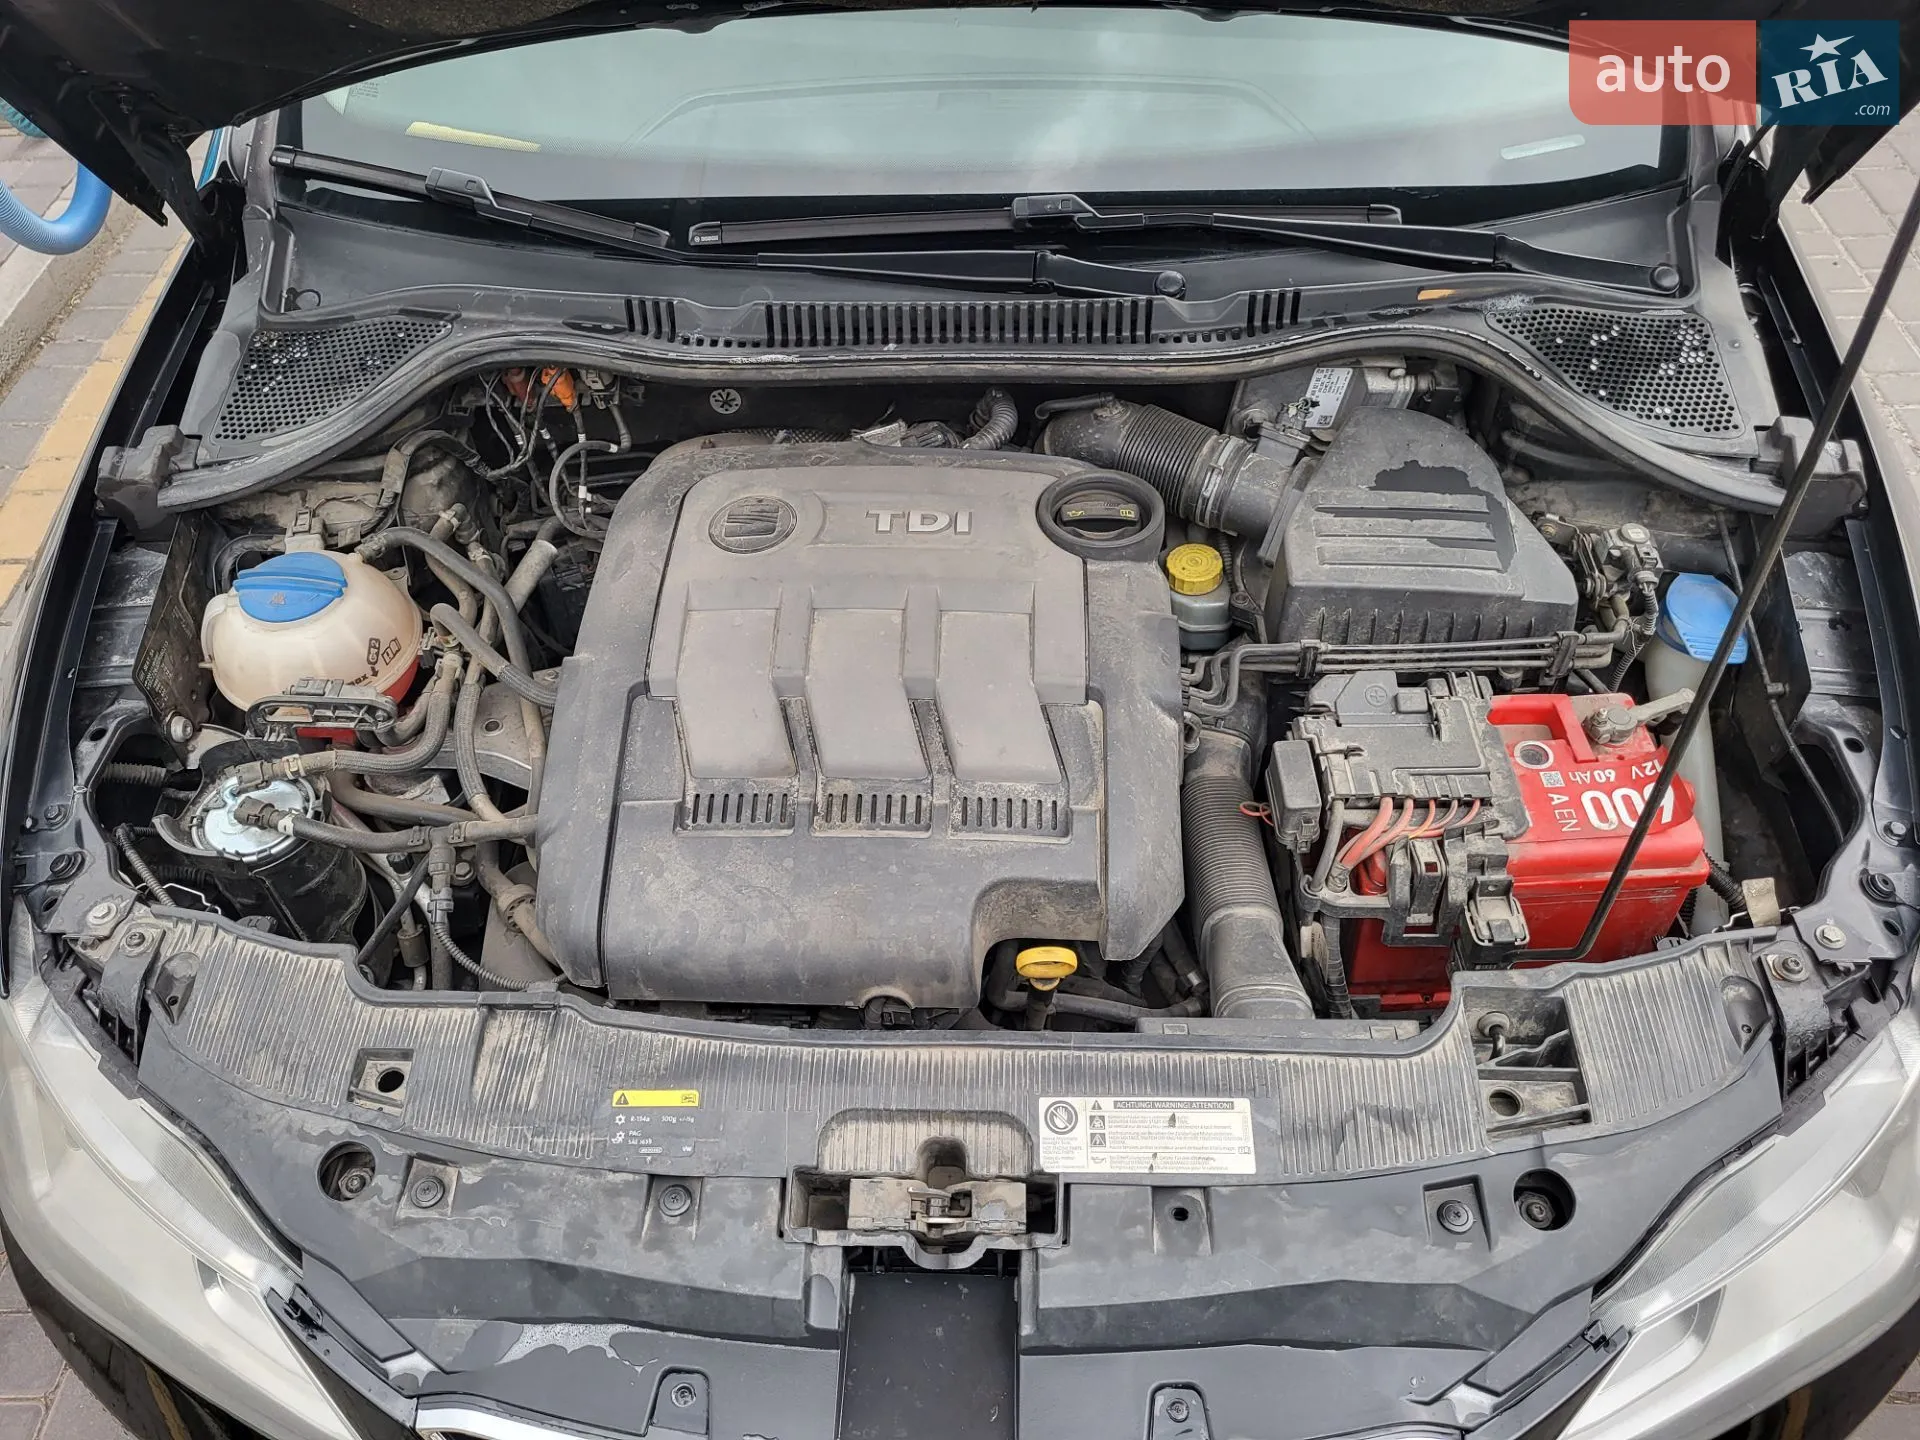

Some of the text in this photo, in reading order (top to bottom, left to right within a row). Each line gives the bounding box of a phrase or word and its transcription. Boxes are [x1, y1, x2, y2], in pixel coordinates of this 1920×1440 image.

[865, 510, 973, 535] TDI
[1580, 782, 1675, 831] 600
[1116, 1101, 1232, 1110] ACHTUNG! WARNING! ATTENTION!
